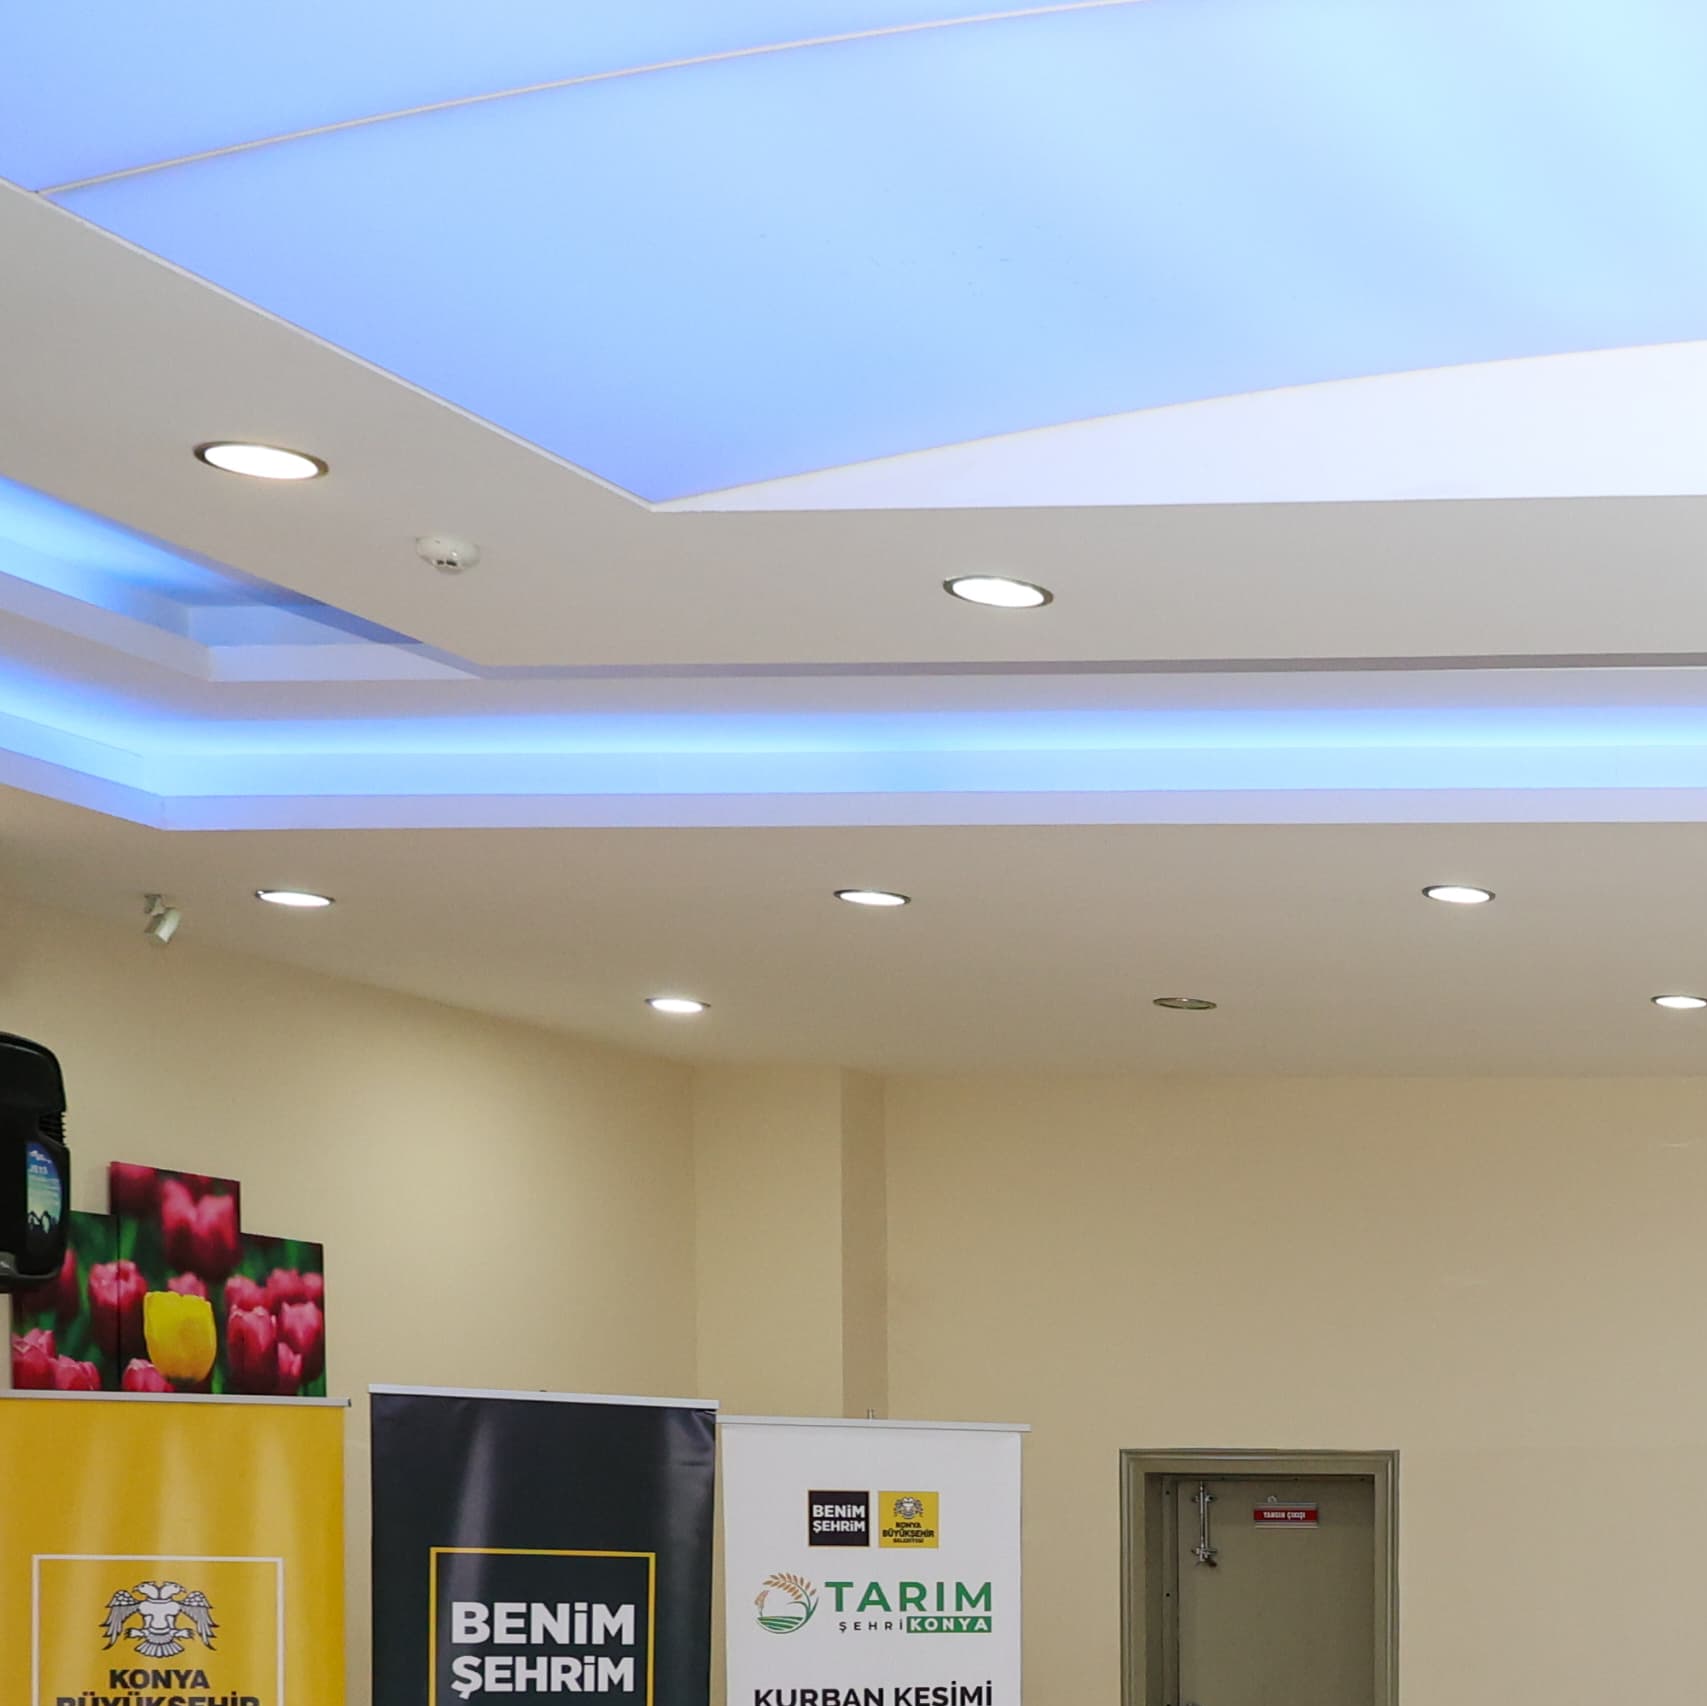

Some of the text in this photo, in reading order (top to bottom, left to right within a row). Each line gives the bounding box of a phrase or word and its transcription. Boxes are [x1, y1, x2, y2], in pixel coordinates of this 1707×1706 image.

[824, 1581, 993, 1613] TARIM
[838, 1617, 989, 1634] ŞEHRİ KONYA
[109, 1668, 210, 1690] KONYA
